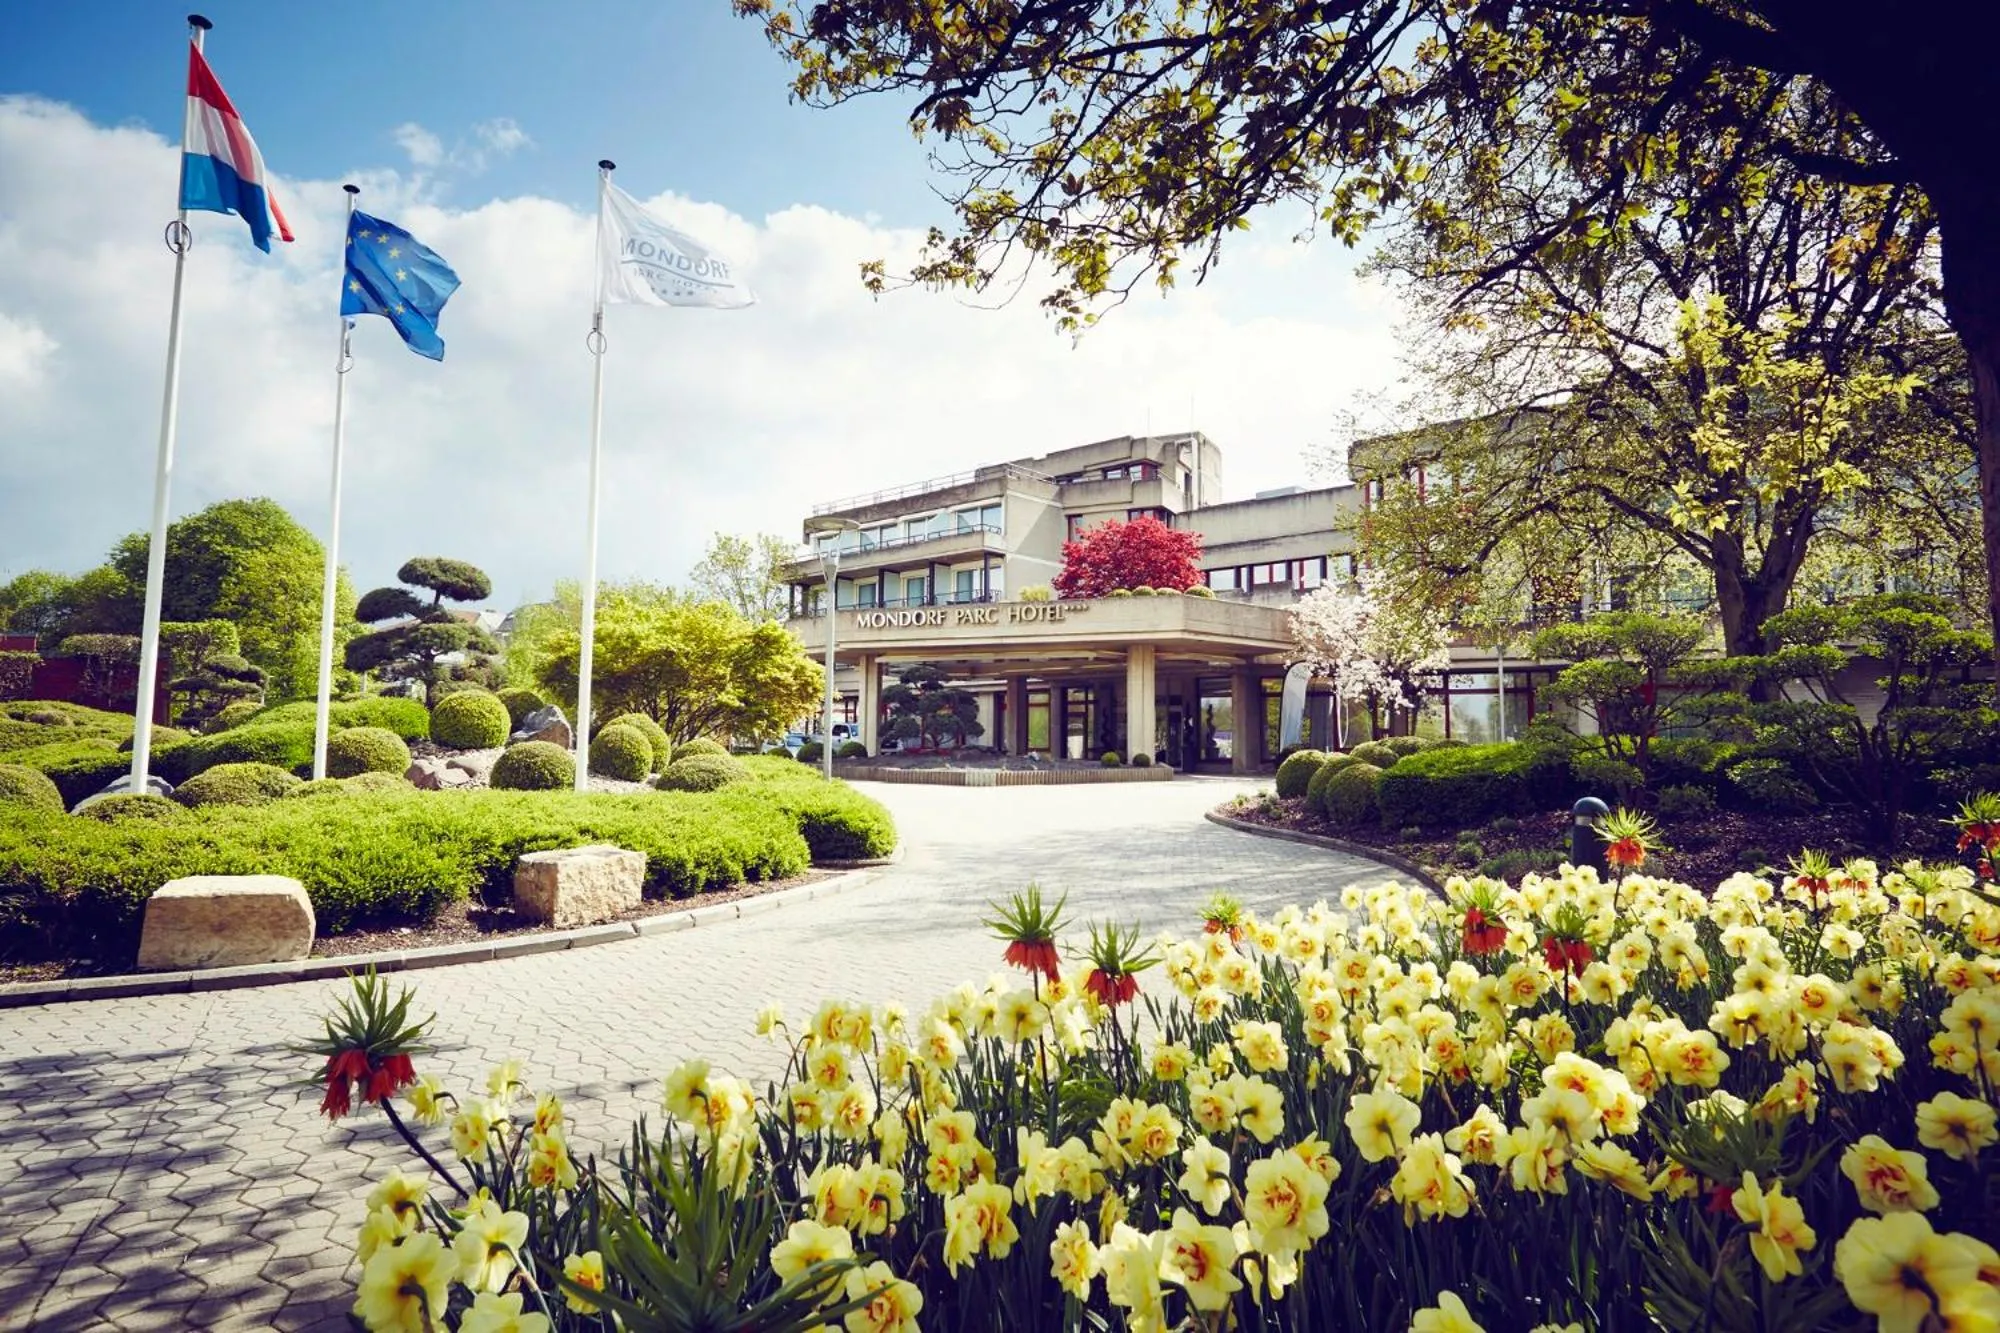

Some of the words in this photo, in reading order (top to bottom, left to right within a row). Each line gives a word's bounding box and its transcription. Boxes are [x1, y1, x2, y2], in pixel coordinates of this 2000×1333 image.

[620, 237, 730, 279] MONDORF
[856, 609, 946, 629] MONDORF
[955, 605, 999, 625] PARC
[1007, 603, 1065, 622] HOTEL
